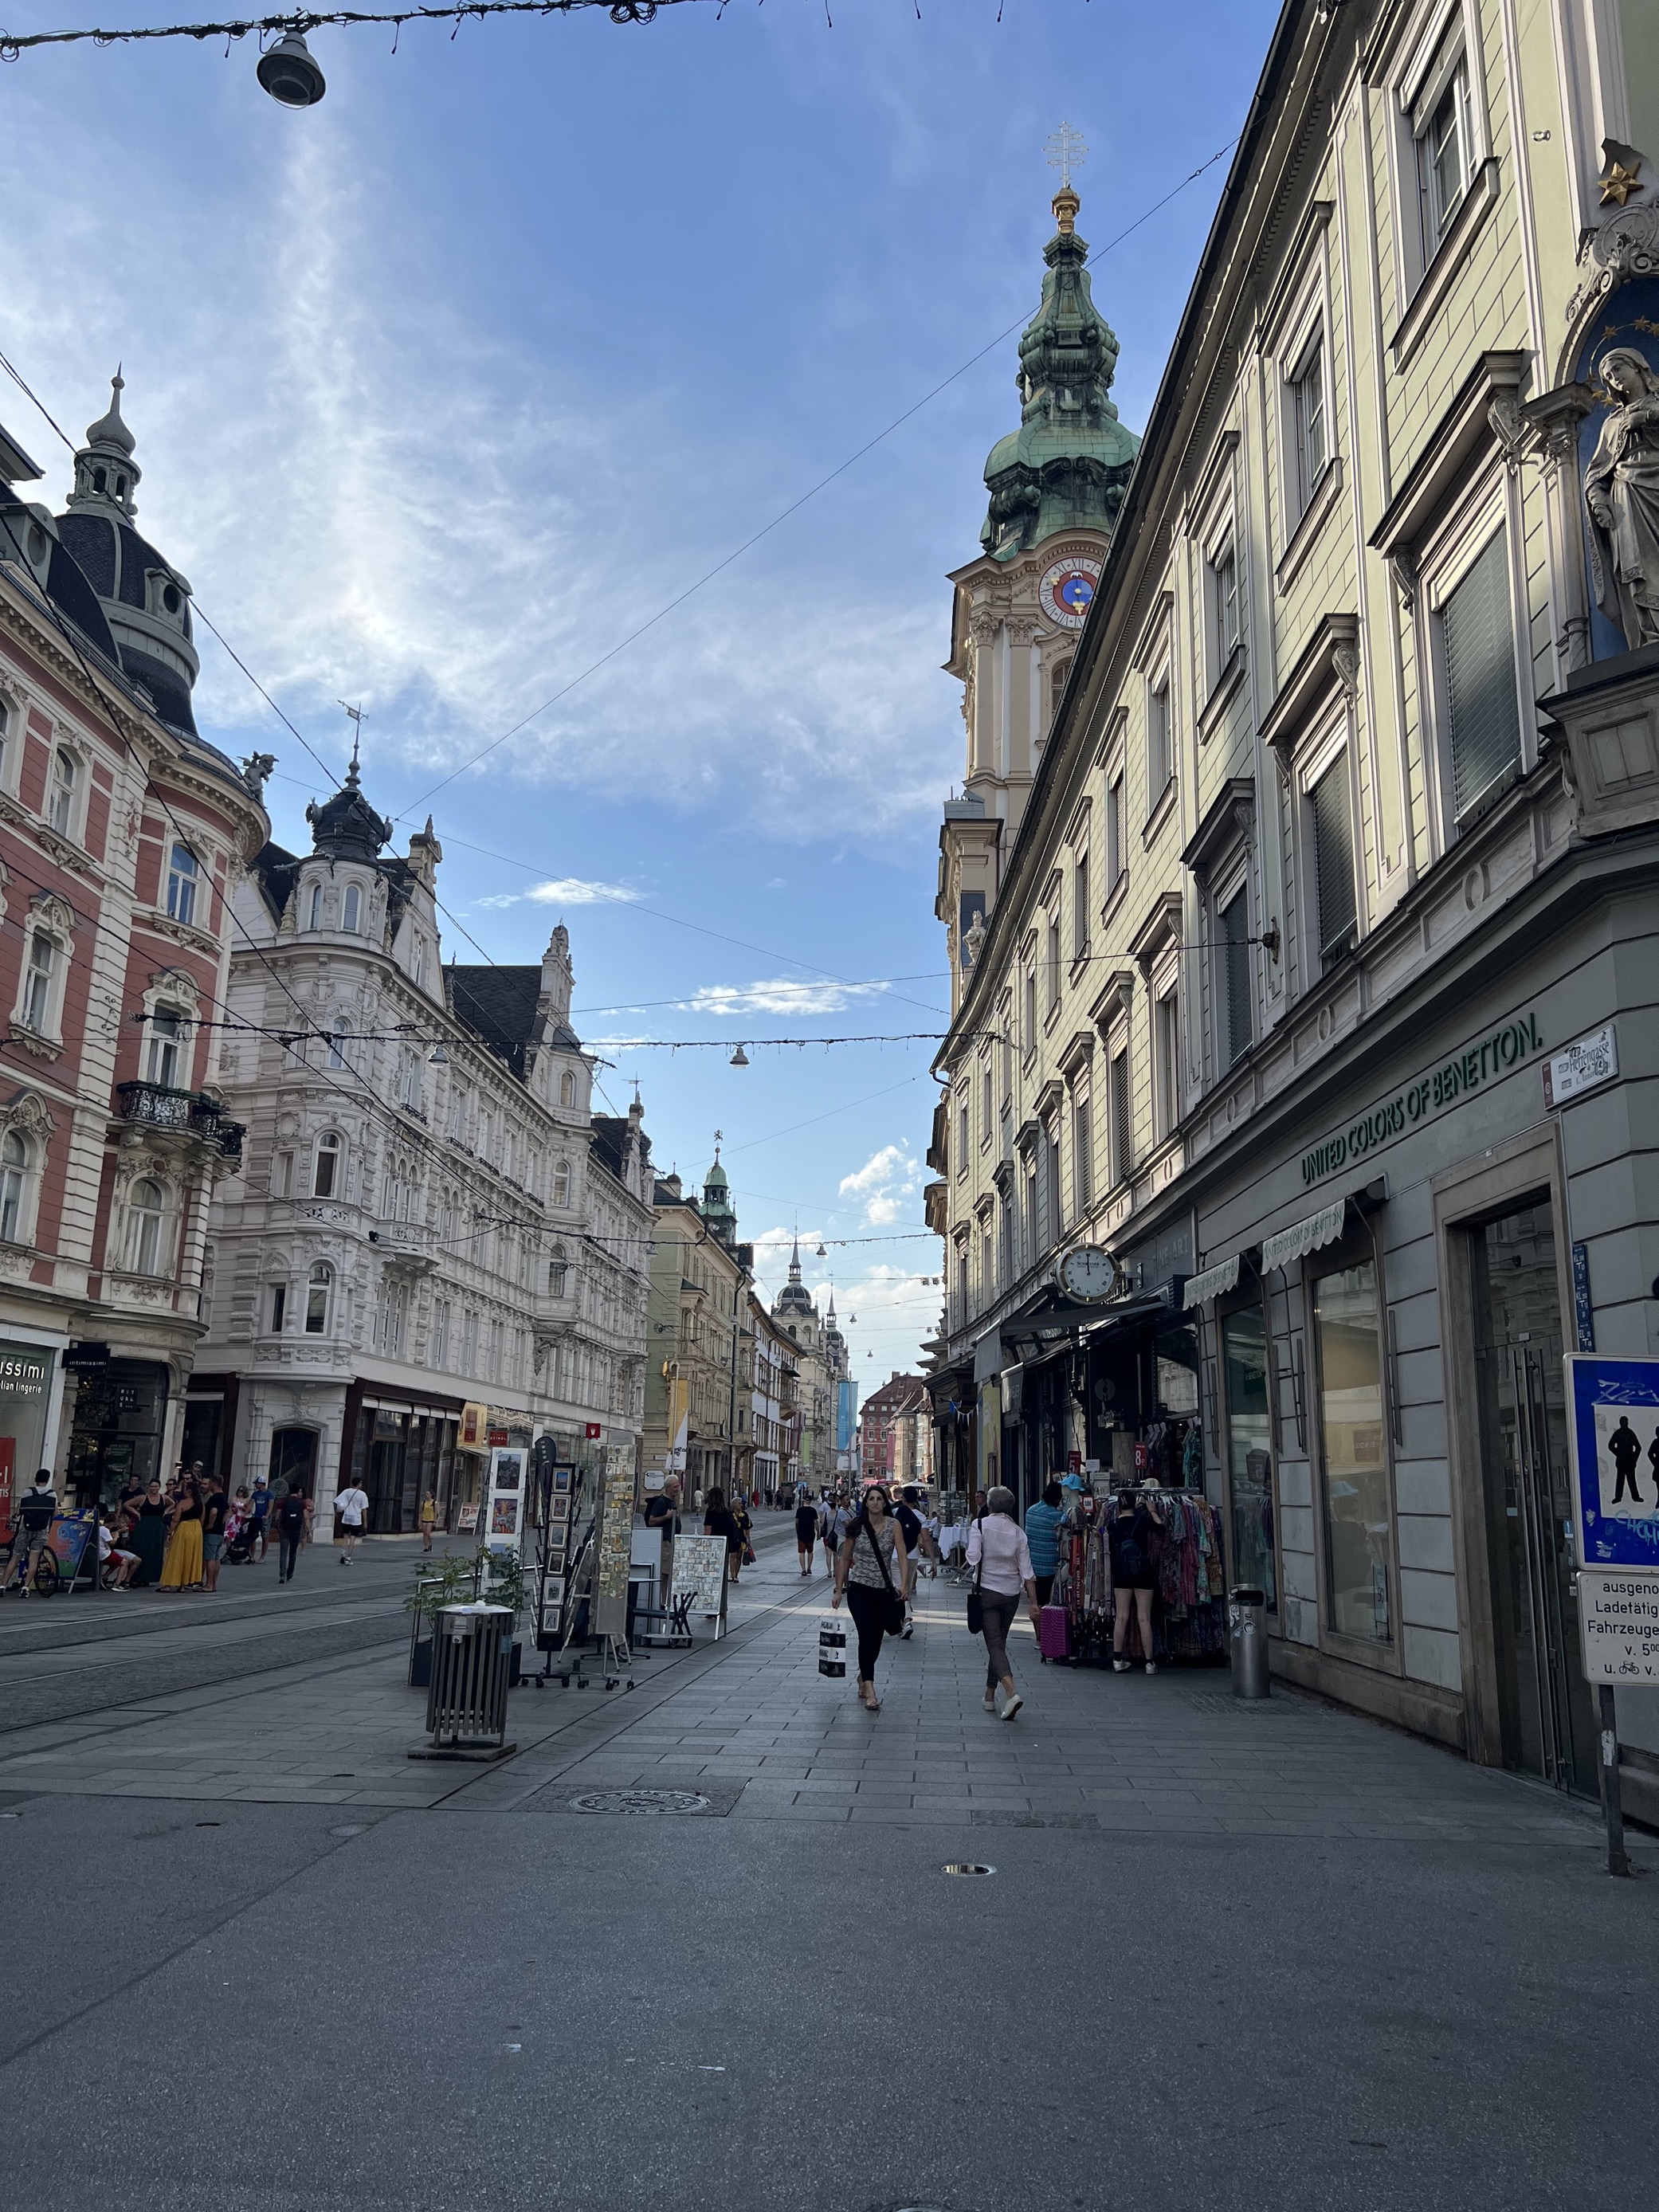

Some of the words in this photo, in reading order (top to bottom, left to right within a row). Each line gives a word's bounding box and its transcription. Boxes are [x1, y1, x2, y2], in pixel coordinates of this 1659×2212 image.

[1569, 1041, 1610, 1073] Herrengasse
[1301, 1135, 1347, 1184] UNITED
[1348, 1096, 1405, 1156] COLORS
[1407, 1079, 1430, 1121] OF
[1173, 1233, 1189, 1257] ART
[0, 1380, 14, 1390] lian
[16, 1382, 42, 1394] lingerie
[1603, 1583, 1659, 1597] ausgeno
[1595, 1600, 1658, 1618] Ladetätig
[1588, 1620, 1659, 1638] Fahrzeuge
[1625, 1645, 1636, 1656] v.
[1604, 1664, 1616, 1674] u.
[1645, 1666, 1657, 1676] v.
